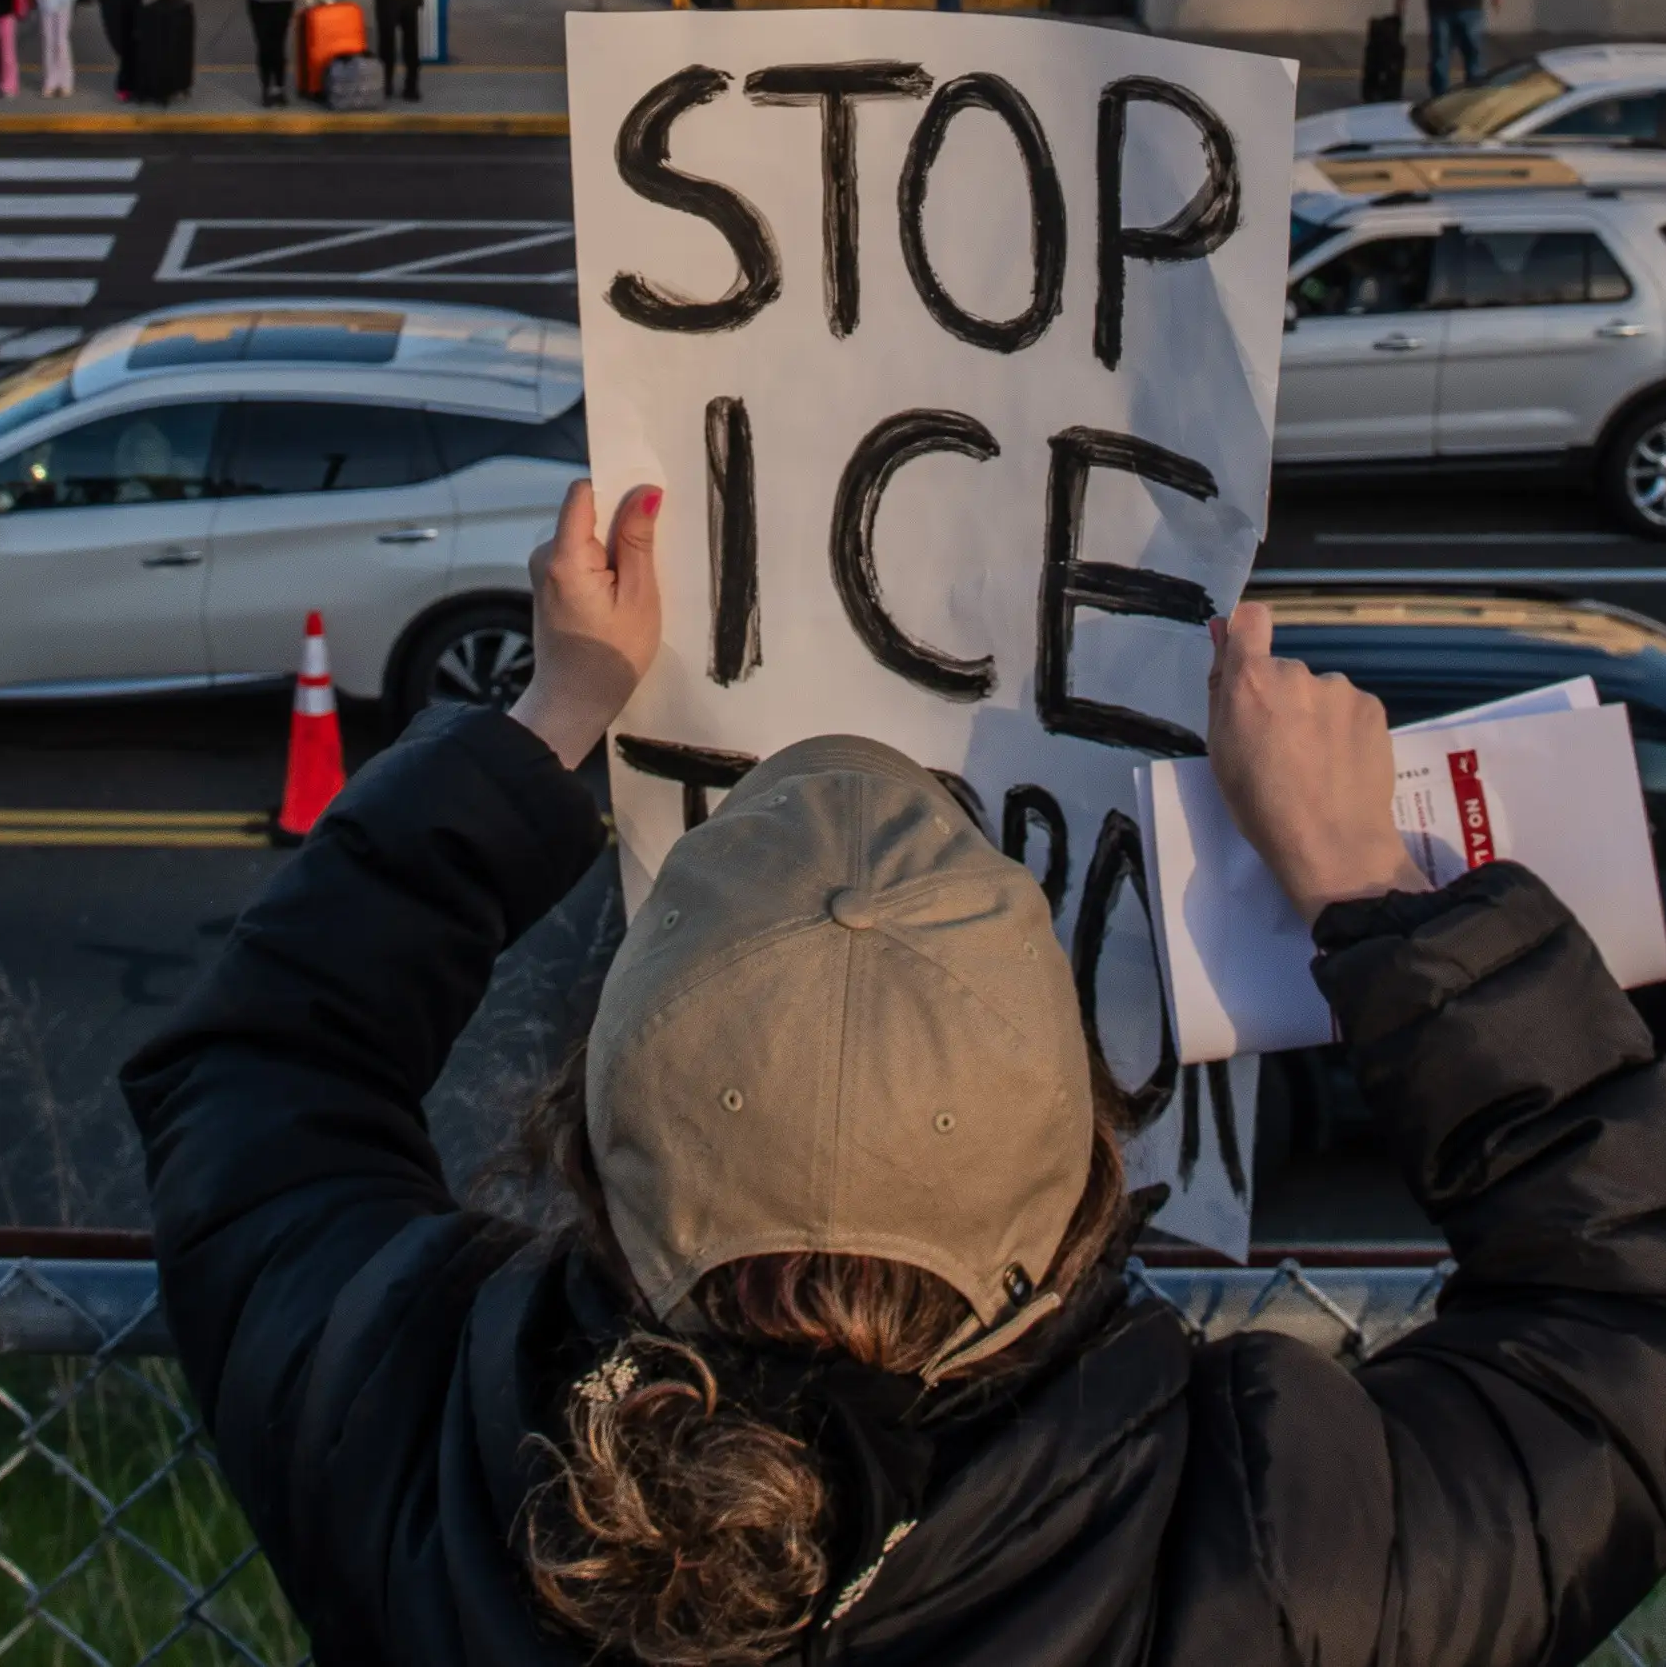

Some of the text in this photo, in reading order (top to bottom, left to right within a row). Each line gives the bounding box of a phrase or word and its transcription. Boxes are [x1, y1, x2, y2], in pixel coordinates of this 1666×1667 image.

[602, 58, 1245, 372] STOP
[704, 395, 1219, 758] ICE
[1464, 796, 1485, 830] NO
